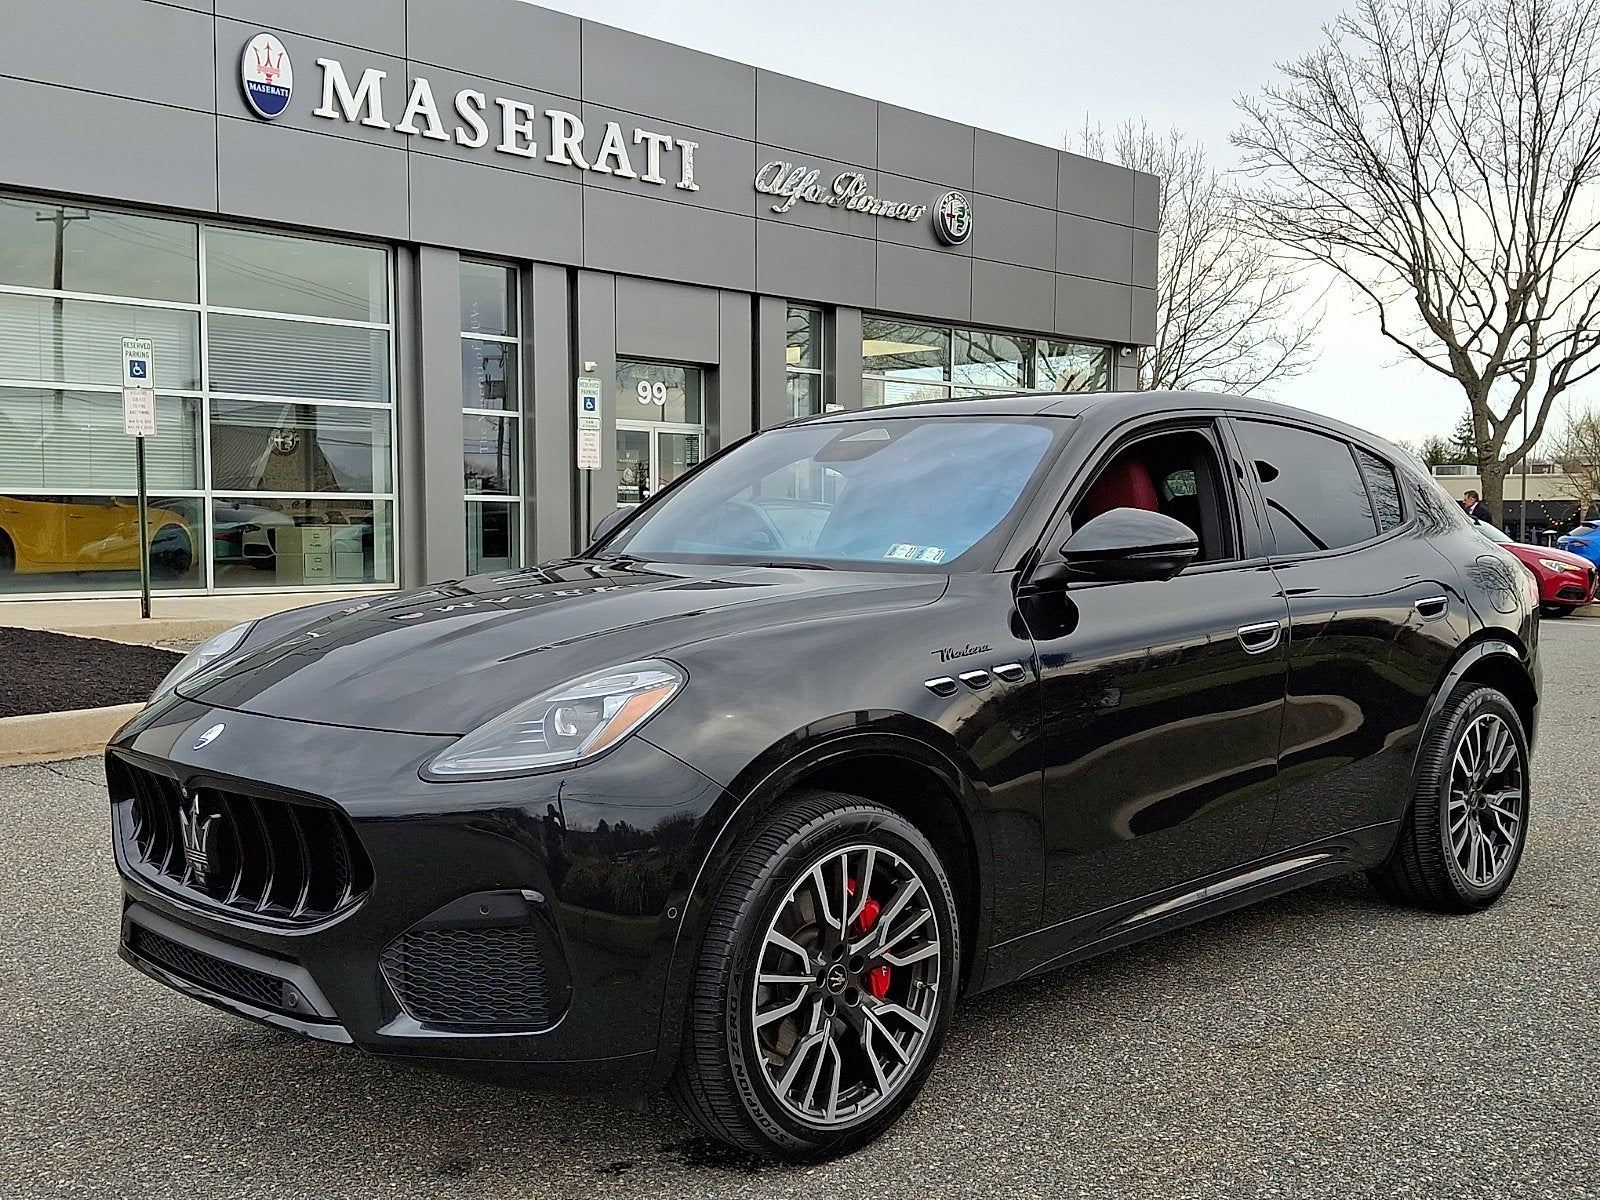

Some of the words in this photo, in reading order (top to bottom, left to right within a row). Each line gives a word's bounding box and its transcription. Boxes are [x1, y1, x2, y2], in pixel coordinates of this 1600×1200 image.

[249, 82, 289, 97] MASERATI
[313, 57, 700, 192] MASERATI
[754, 160, 831, 213] Alfa
[830, 171, 927, 222] Romeo
[123, 341, 151, 350] RESERVED
[125, 350, 150, 359] PARKING
[637, 380, 667, 406] 99
[931, 644, 993, 662] Modena
[729, 996, 741, 1059] ZERO
[734, 1064, 788, 1144] SCORPION
